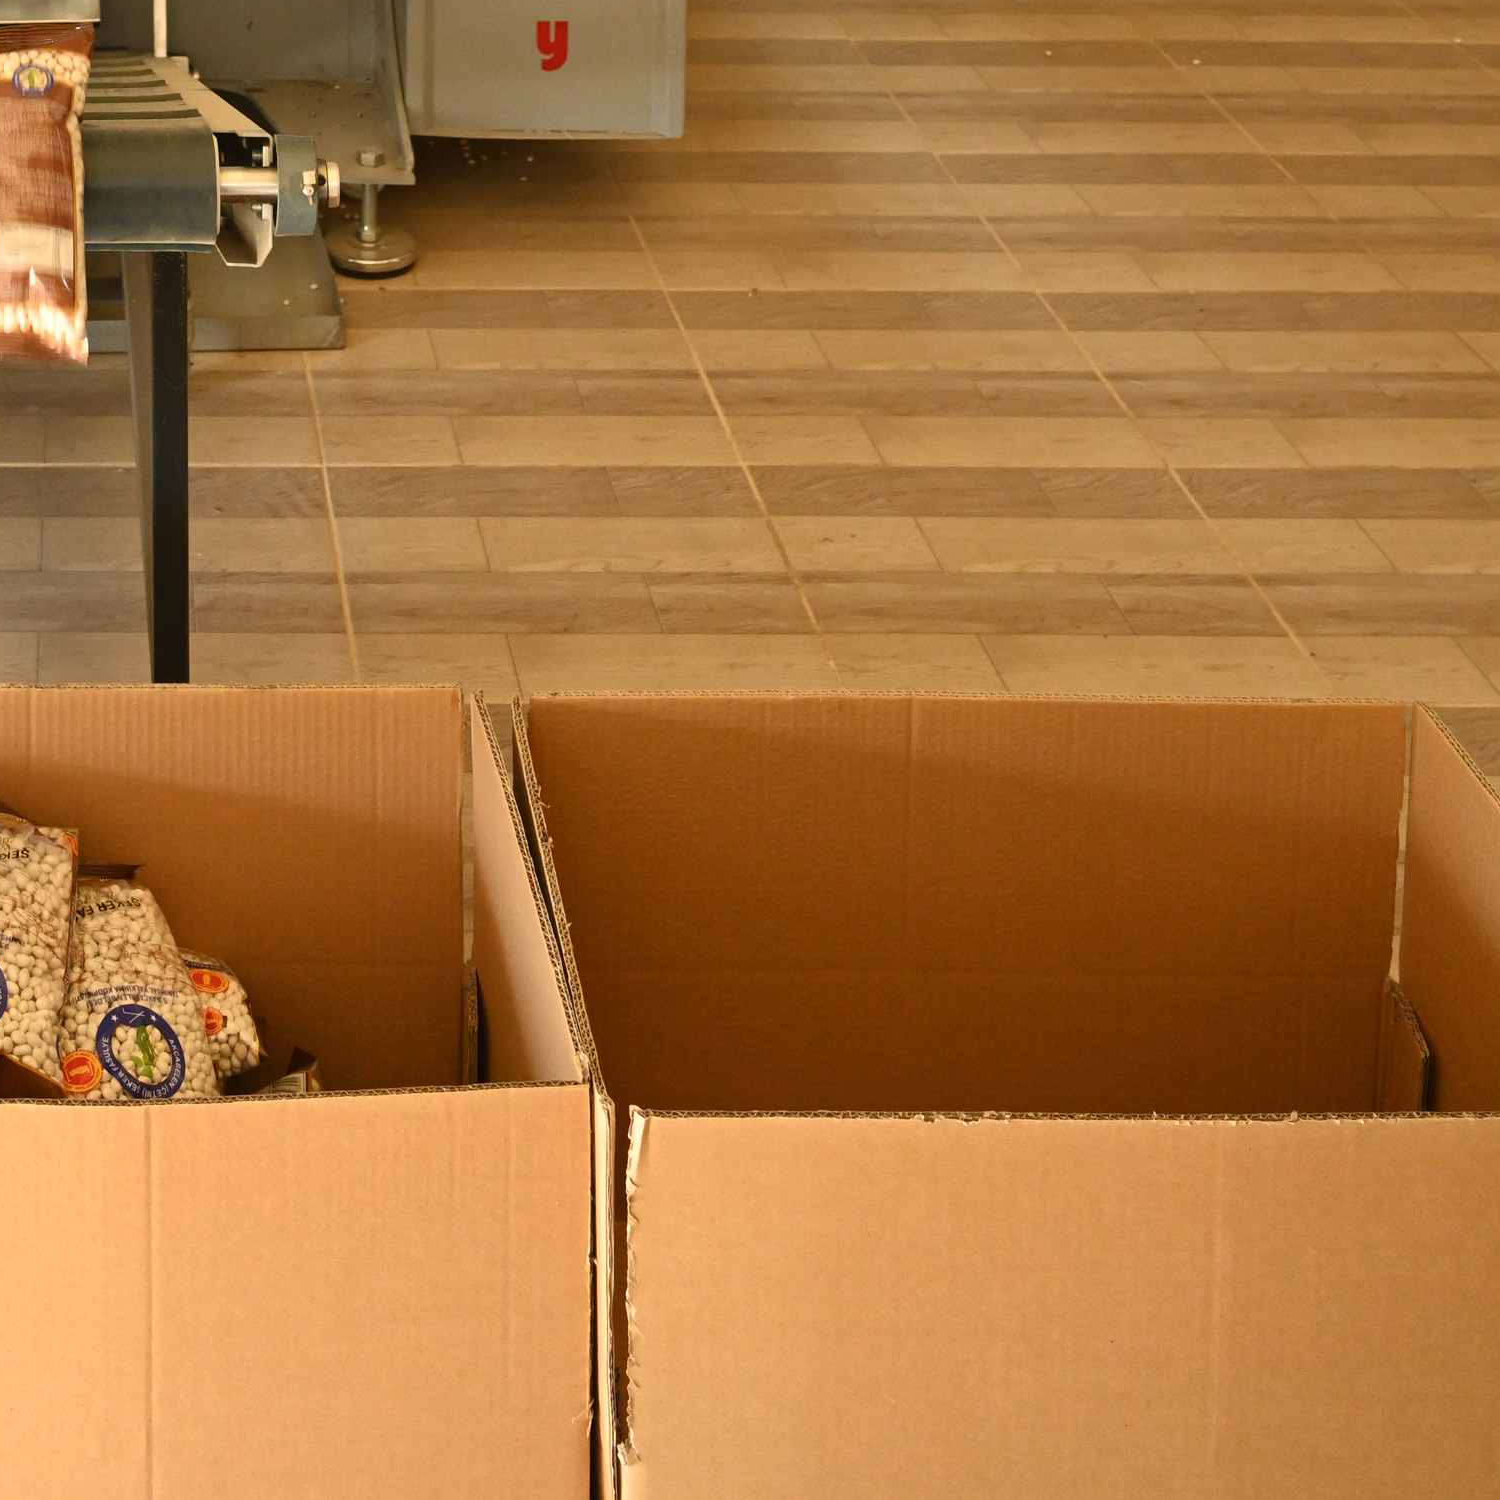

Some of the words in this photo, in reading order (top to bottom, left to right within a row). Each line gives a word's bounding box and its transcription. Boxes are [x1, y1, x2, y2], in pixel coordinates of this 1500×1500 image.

[101, 1036, 119, 1073] FASULYE
[168, 1038, 182, 1088] AKÇABELEN
[117, 1069, 142, 1094] ŞEKER
